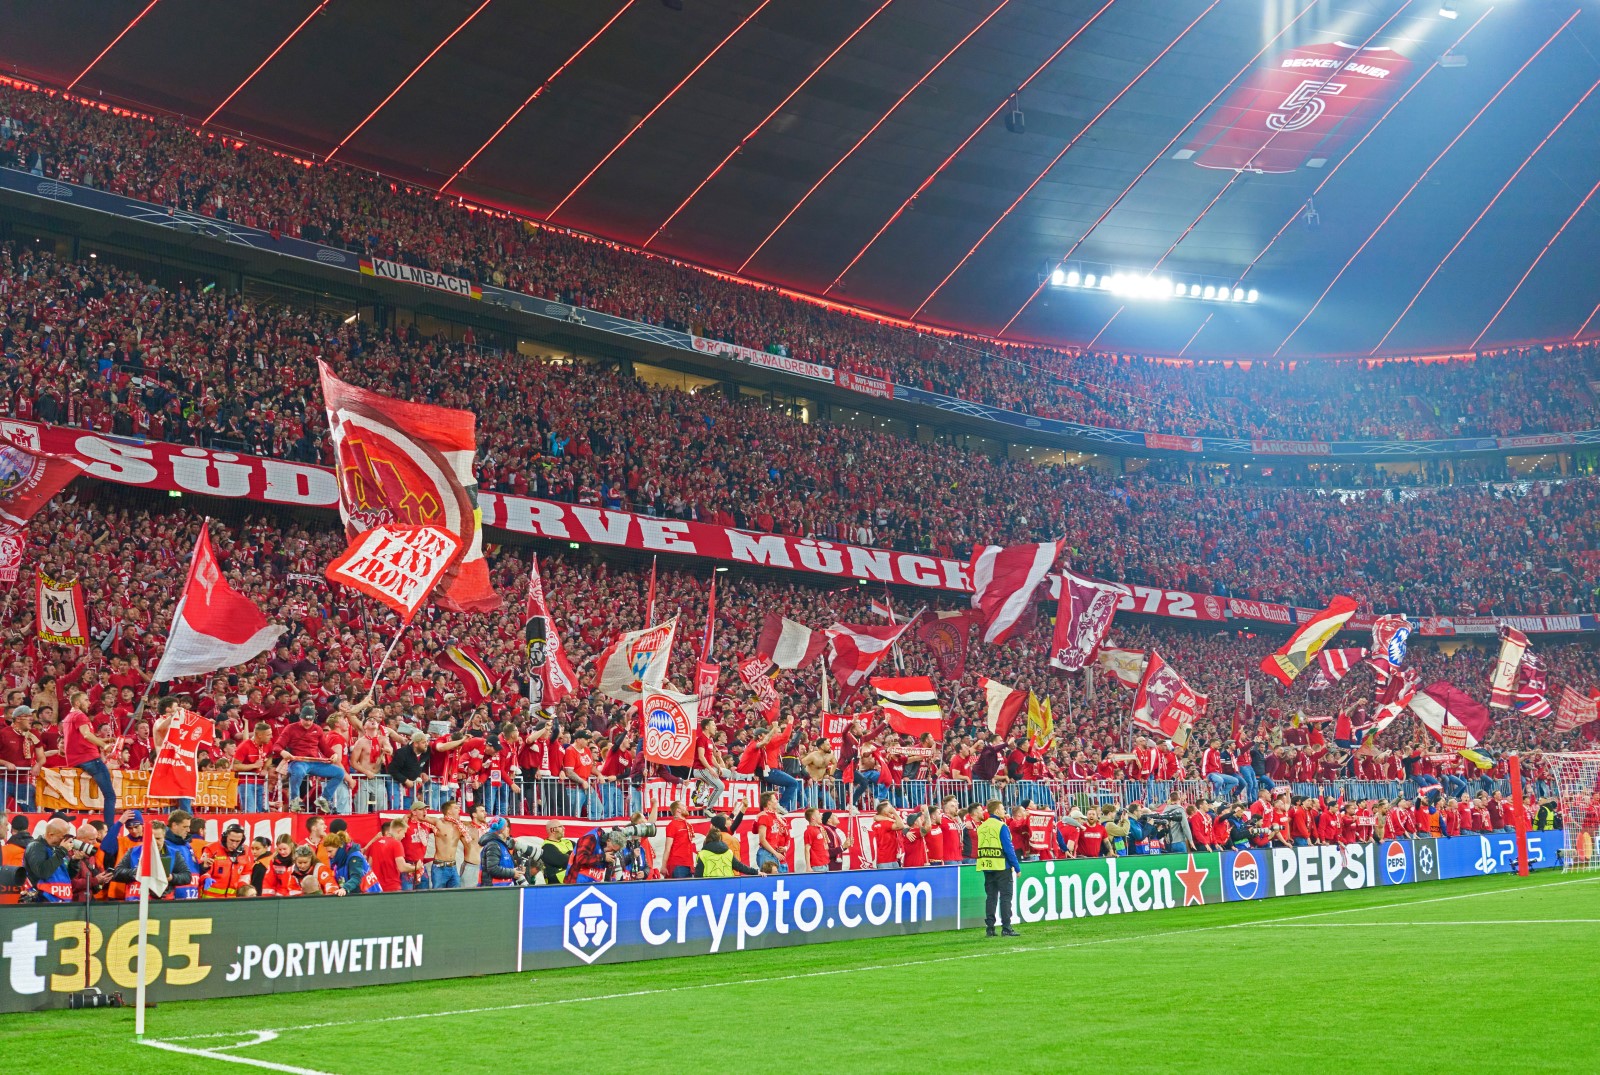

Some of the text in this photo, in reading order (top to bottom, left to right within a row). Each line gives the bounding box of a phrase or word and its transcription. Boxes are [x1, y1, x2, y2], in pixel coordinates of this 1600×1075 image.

[1266, 80, 1347, 131] 5
[374, 259, 470, 294] KULMBACH
[39, 630, 85, 645] MÜNCHEN
[646, 728, 691, 760] 007
[1235, 870, 1258, 880] PEPSI
[1273, 843, 1375, 896] PEPSI
[1388, 857, 1405, 868] PEPSI
[640, 880, 933, 954] crypto.com
